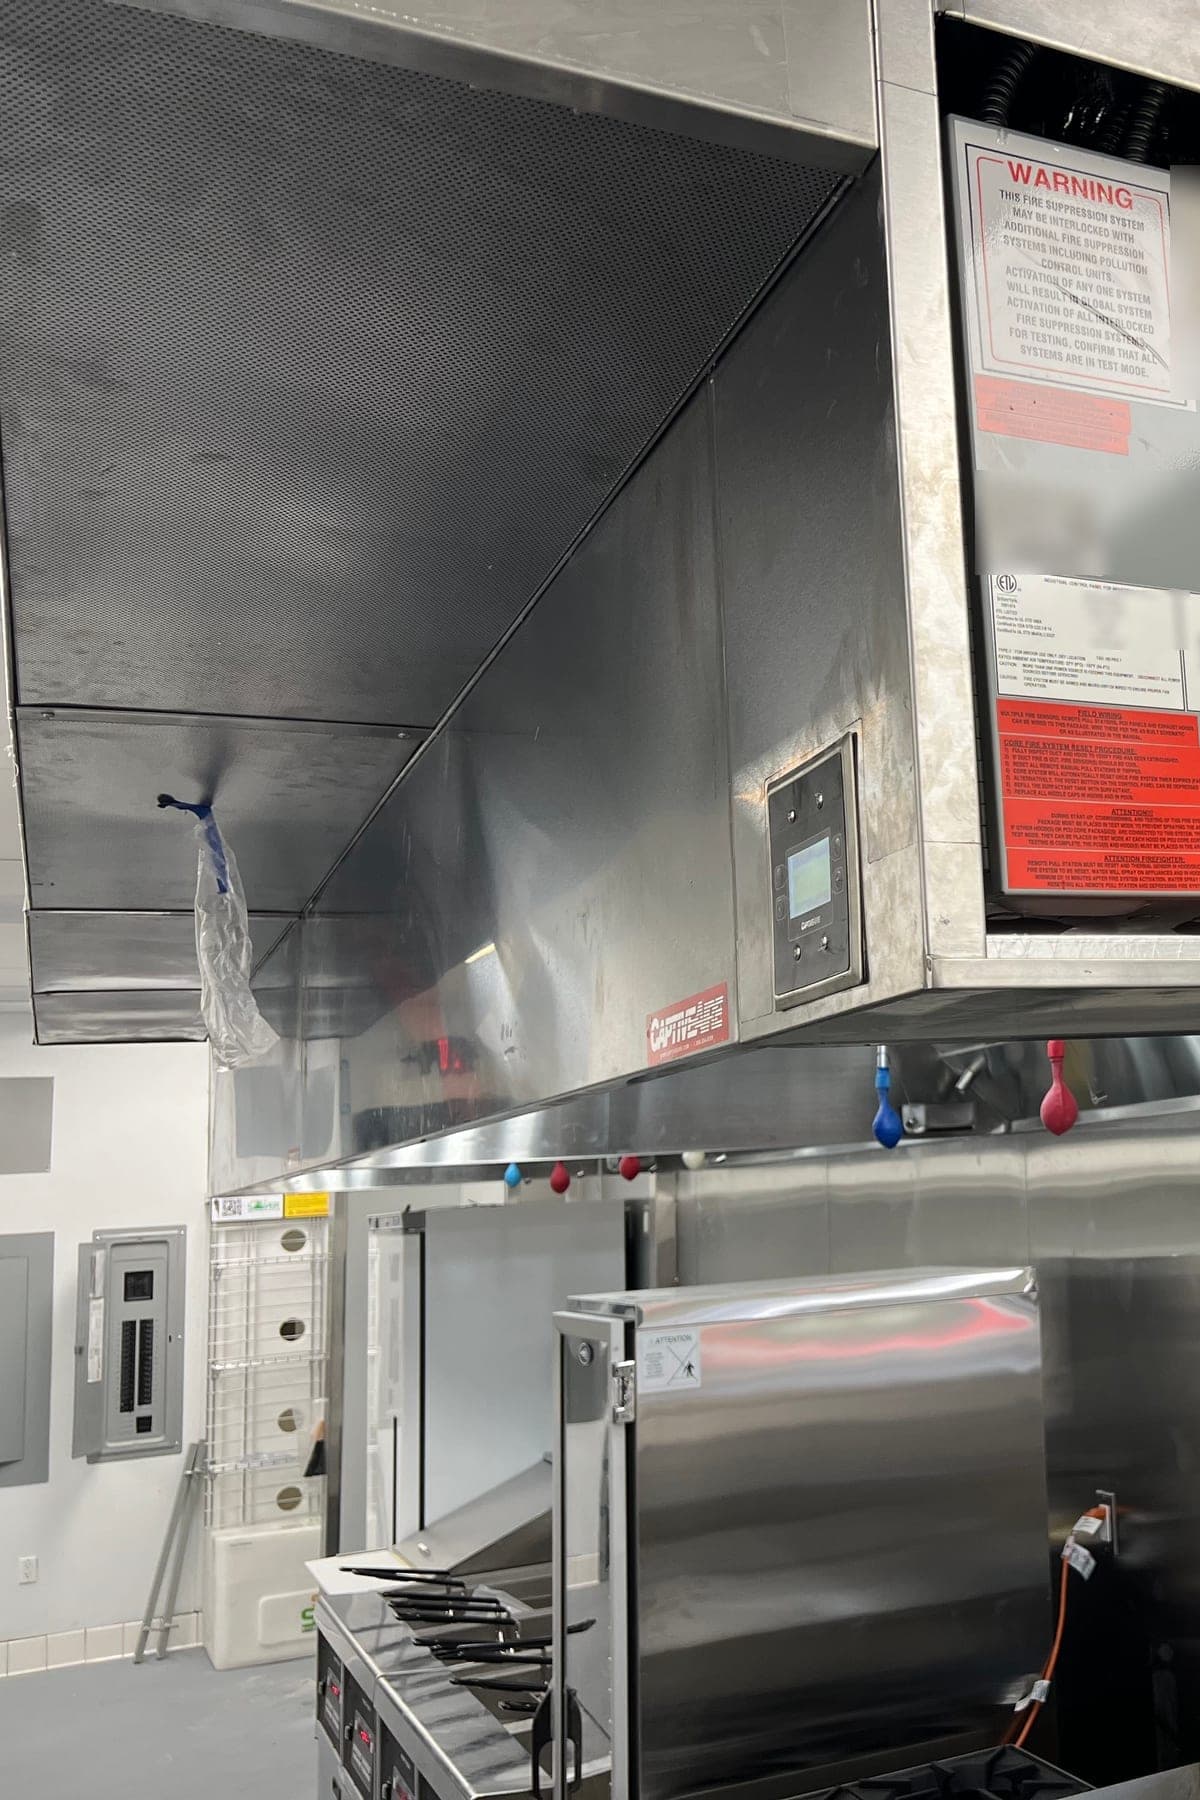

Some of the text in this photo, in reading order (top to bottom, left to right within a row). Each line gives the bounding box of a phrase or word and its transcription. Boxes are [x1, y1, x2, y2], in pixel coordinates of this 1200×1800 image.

[1007, 161, 1133, 209] WARNING
[1000, 190, 1144, 231] THIS FIRE SUPPRESSION SYSTEM
[1013, 208, 1134, 243] MAY BE INTERLOCKED WITH
[1004, 235, 1148, 275] SYSTEMS INCLUDING POLLUTION
[1005, 221, 1144, 259] ADDITIONAL FIRE SUPPRESSION
[1006, 266, 1151, 304] ACTIVATION OF ANY ONE SYSTEM
[1041, 258, 1115, 283] CONTROL UNITS.
[1007, 281, 1029, 294] WILL
[1032, 286, 1065, 302] RESULT
[1081, 296, 1115, 312] GLOBAL
[1118, 304, 1152, 319] SYSTEM
[1008, 297, 1060, 315] ACTIVATION
[1063, 308, 1075, 318] OF
[1078, 311, 1095, 322] ALL
[1017, 314, 1037, 326] FIRE
[1040, 318, 1101, 338] SUPPRESSION
[1010, 328, 1028, 340] FOR
[1075, 340, 1115, 356] CONFIRM
[1117, 349, 1139, 360] THAT
[1142, 353, 1157, 364] ALL
[1020, 345, 1149, 377] SYSTEMS ARE IN TEST MODE.
